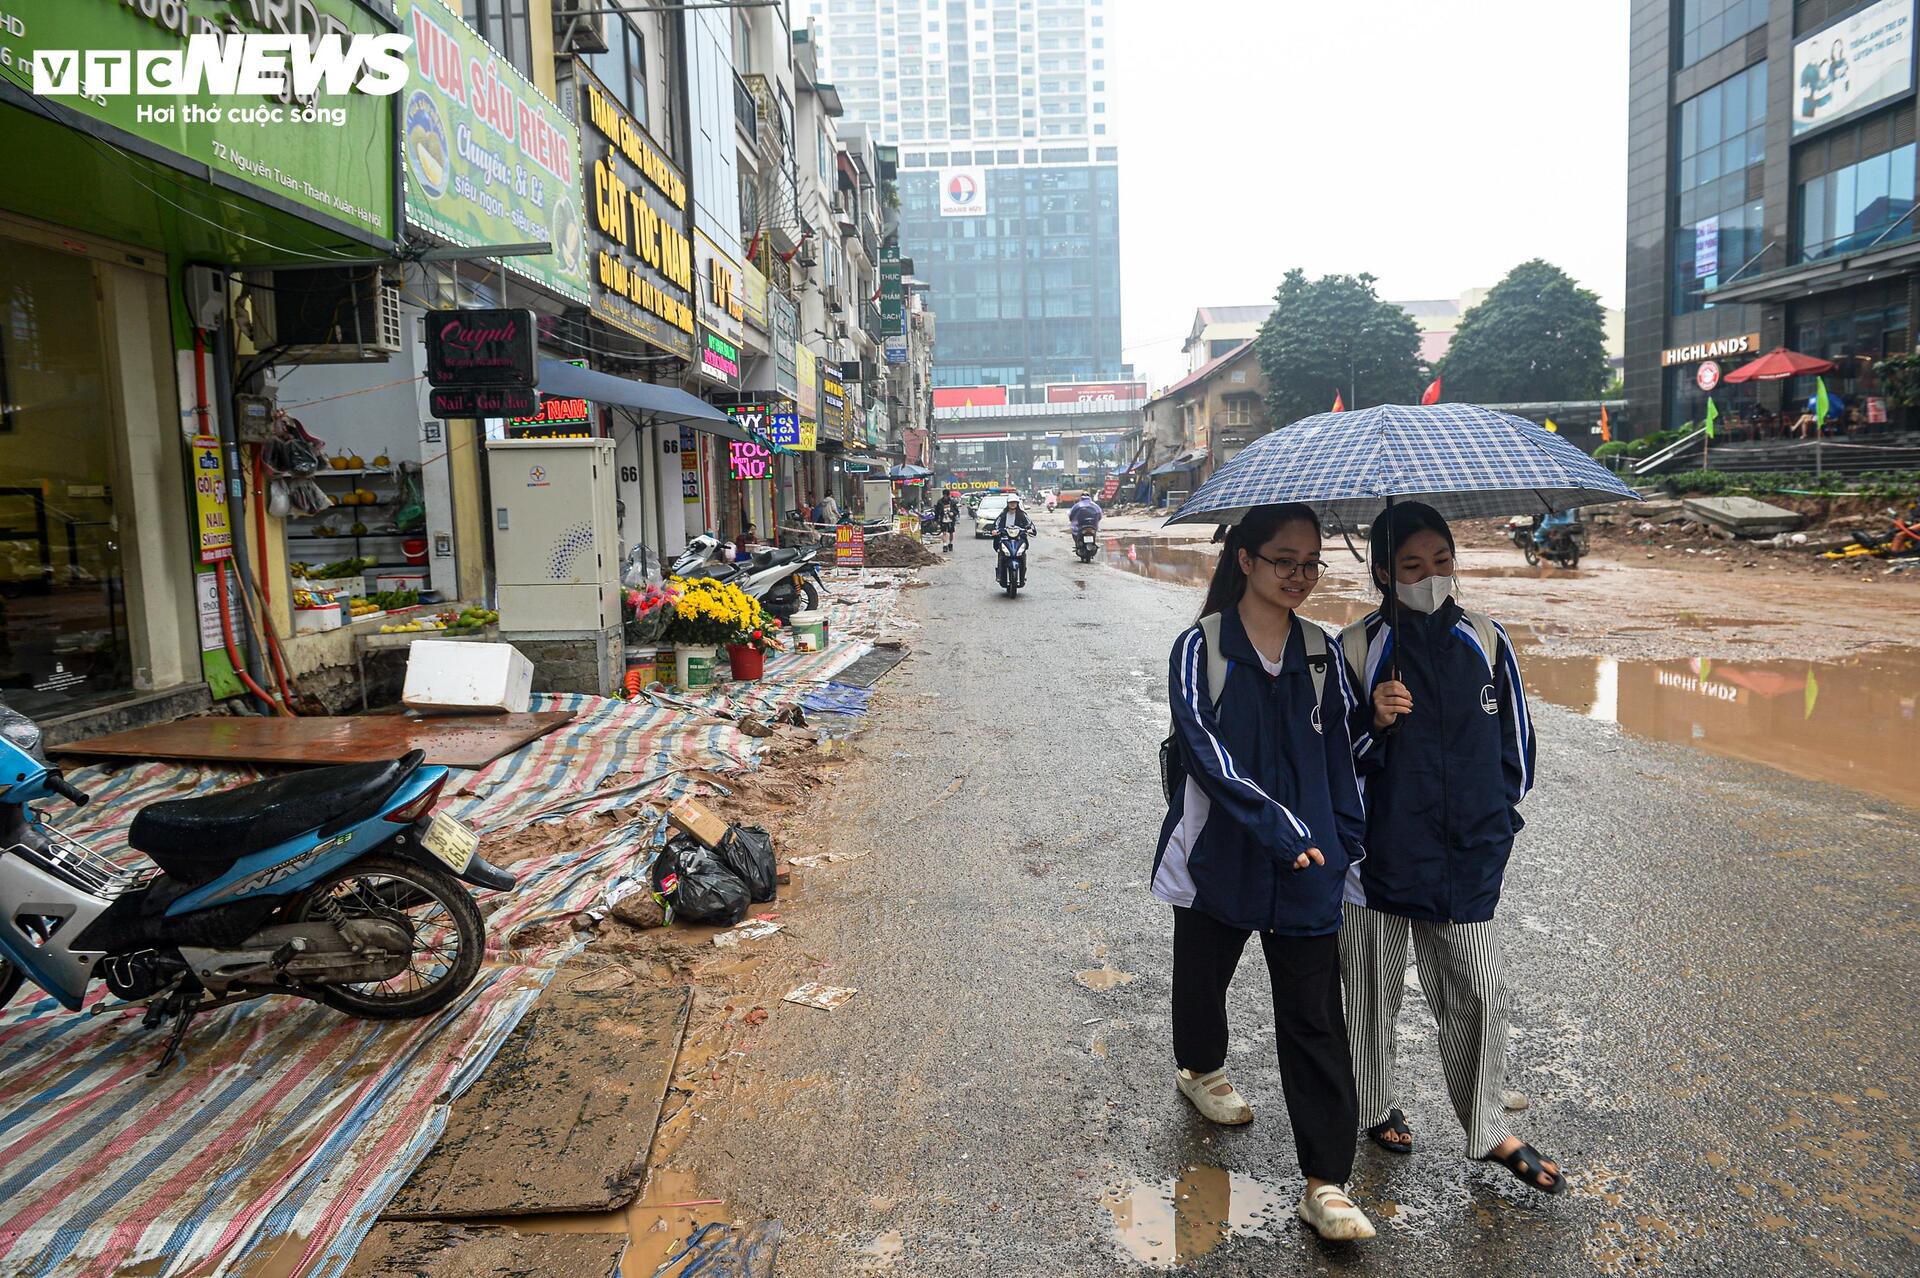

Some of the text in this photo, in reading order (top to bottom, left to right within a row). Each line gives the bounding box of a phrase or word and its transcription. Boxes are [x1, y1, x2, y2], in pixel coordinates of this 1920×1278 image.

[413, 7, 467, 106] VUA
[471, 57, 514, 143] SẦU
[517, 98, 571, 186] RIÊNG
[212, 140, 227, 160] 72
[230, 149, 272, 179] Nguyễn
[480, 190, 504, 218] ngon
[595, 144, 627, 247] CẮT
[630, 186, 660, 270] TÓC
[660, 217, 692, 293] NAM
[1666, 336, 1749, 365] HIGHLANDS
[435, 395, 463, 410] Nail
[547, 399, 586, 420] NAM
[664, 439, 678, 454] 66
[1041, 461, 1058, 469] ACB
[621, 466, 638, 482] 66
[945, 481, 999, 490] GOLD TOWER
[206, 512, 226, 528] NAIL
[202, 532, 231, 546] Skincare
